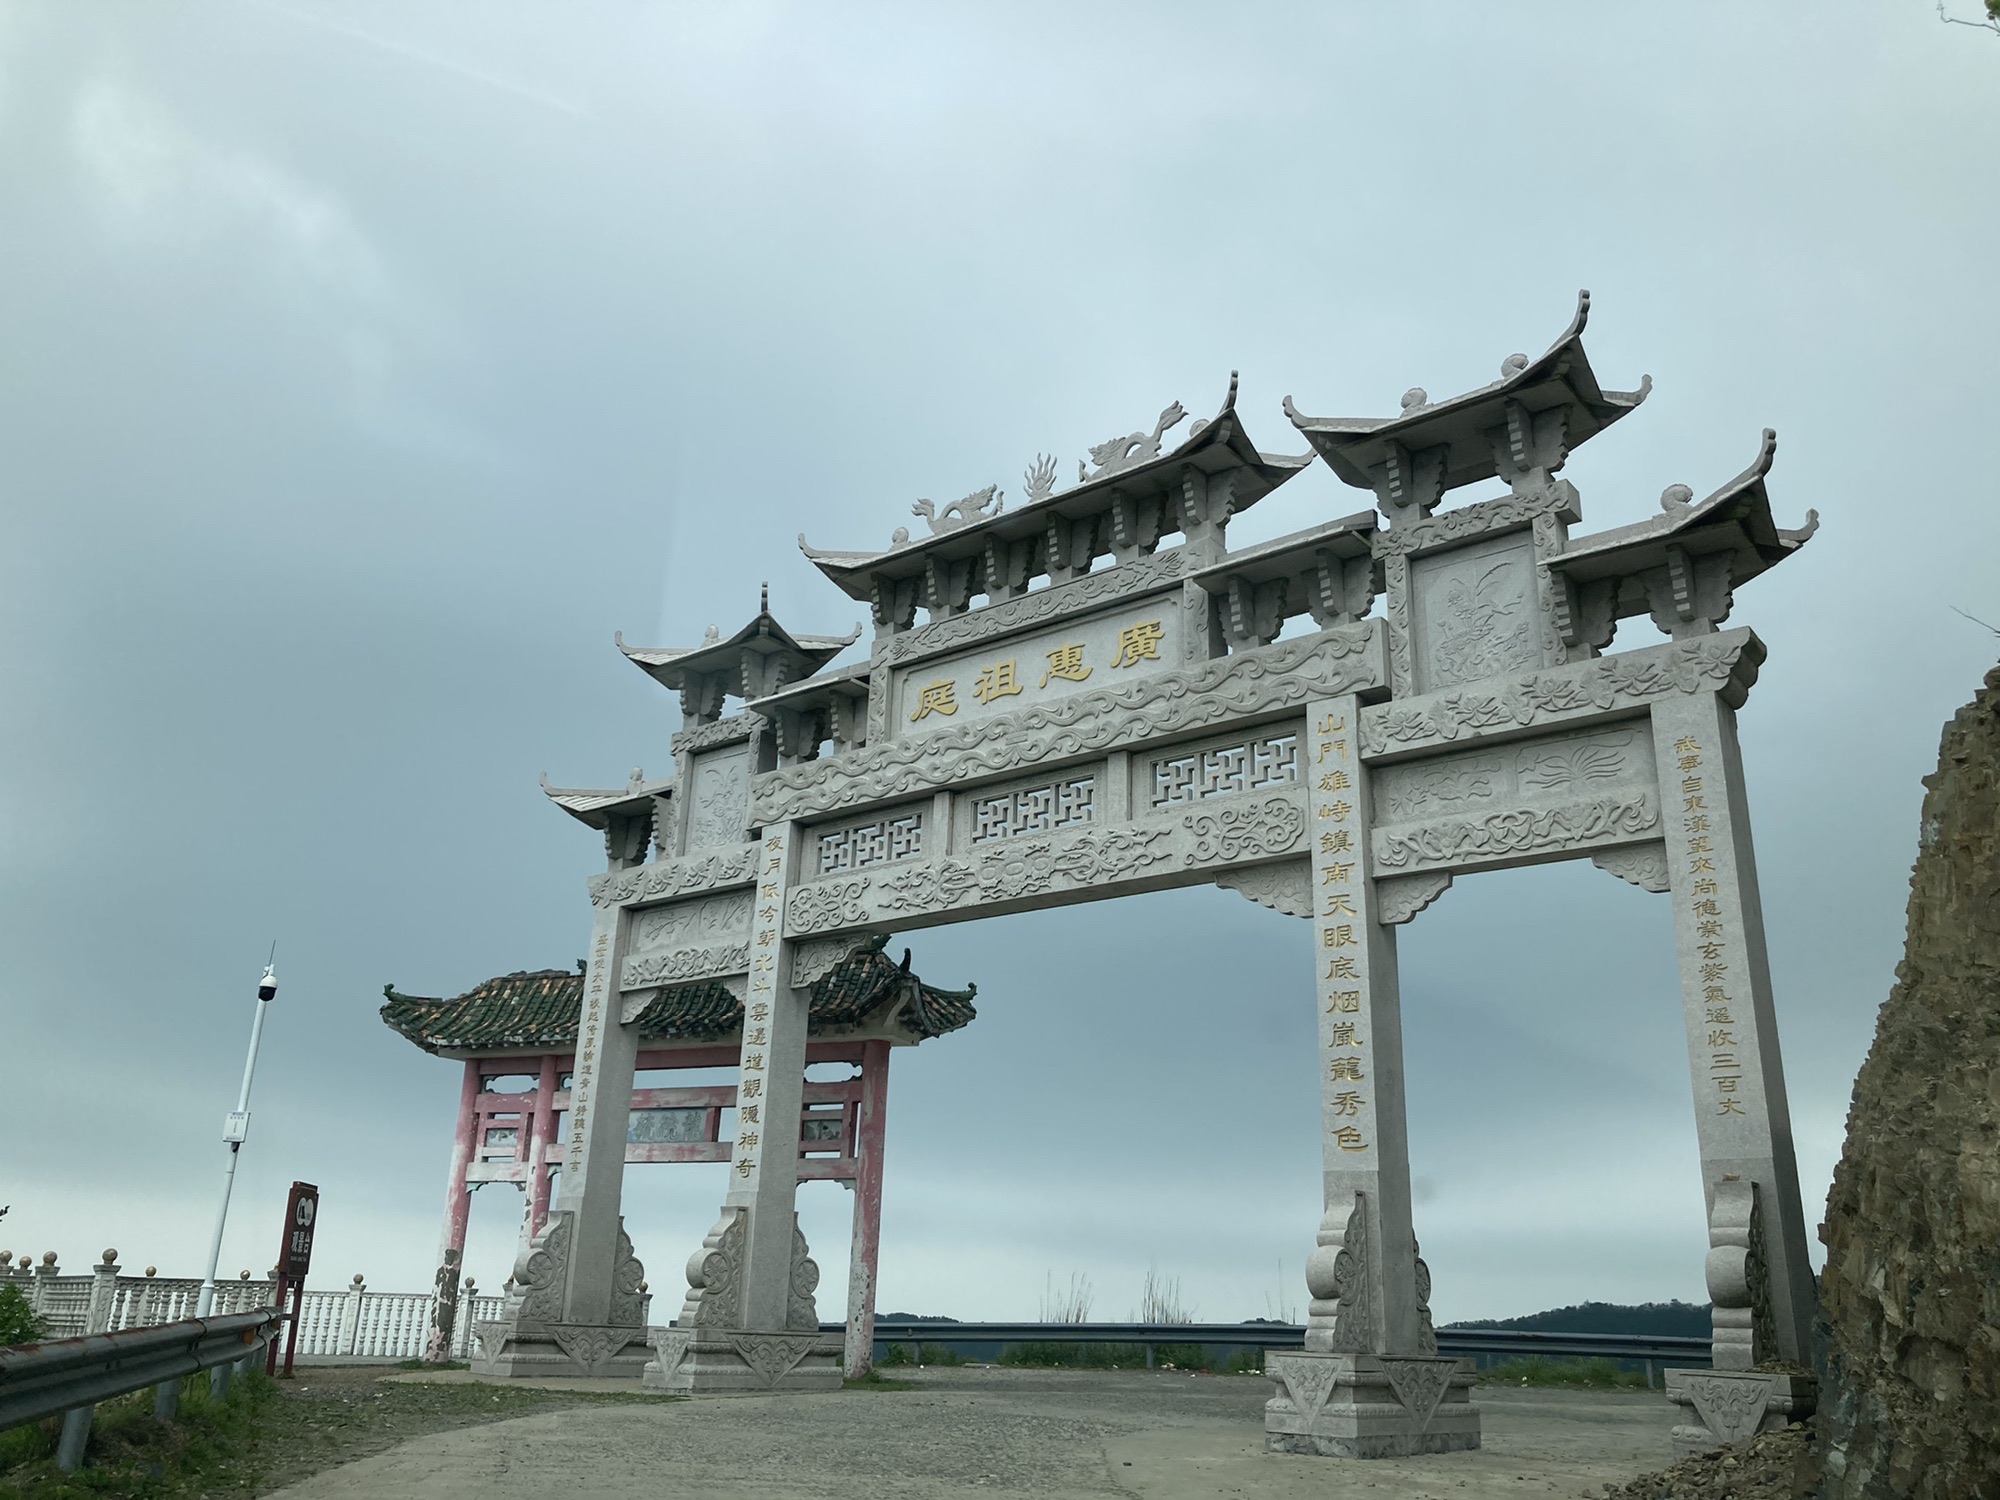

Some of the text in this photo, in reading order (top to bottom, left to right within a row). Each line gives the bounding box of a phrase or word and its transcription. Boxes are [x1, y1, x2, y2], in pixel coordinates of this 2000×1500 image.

[910, 620, 1165, 722] 廣惠祖庭
[291, 1231, 311, 1254] 观景台
